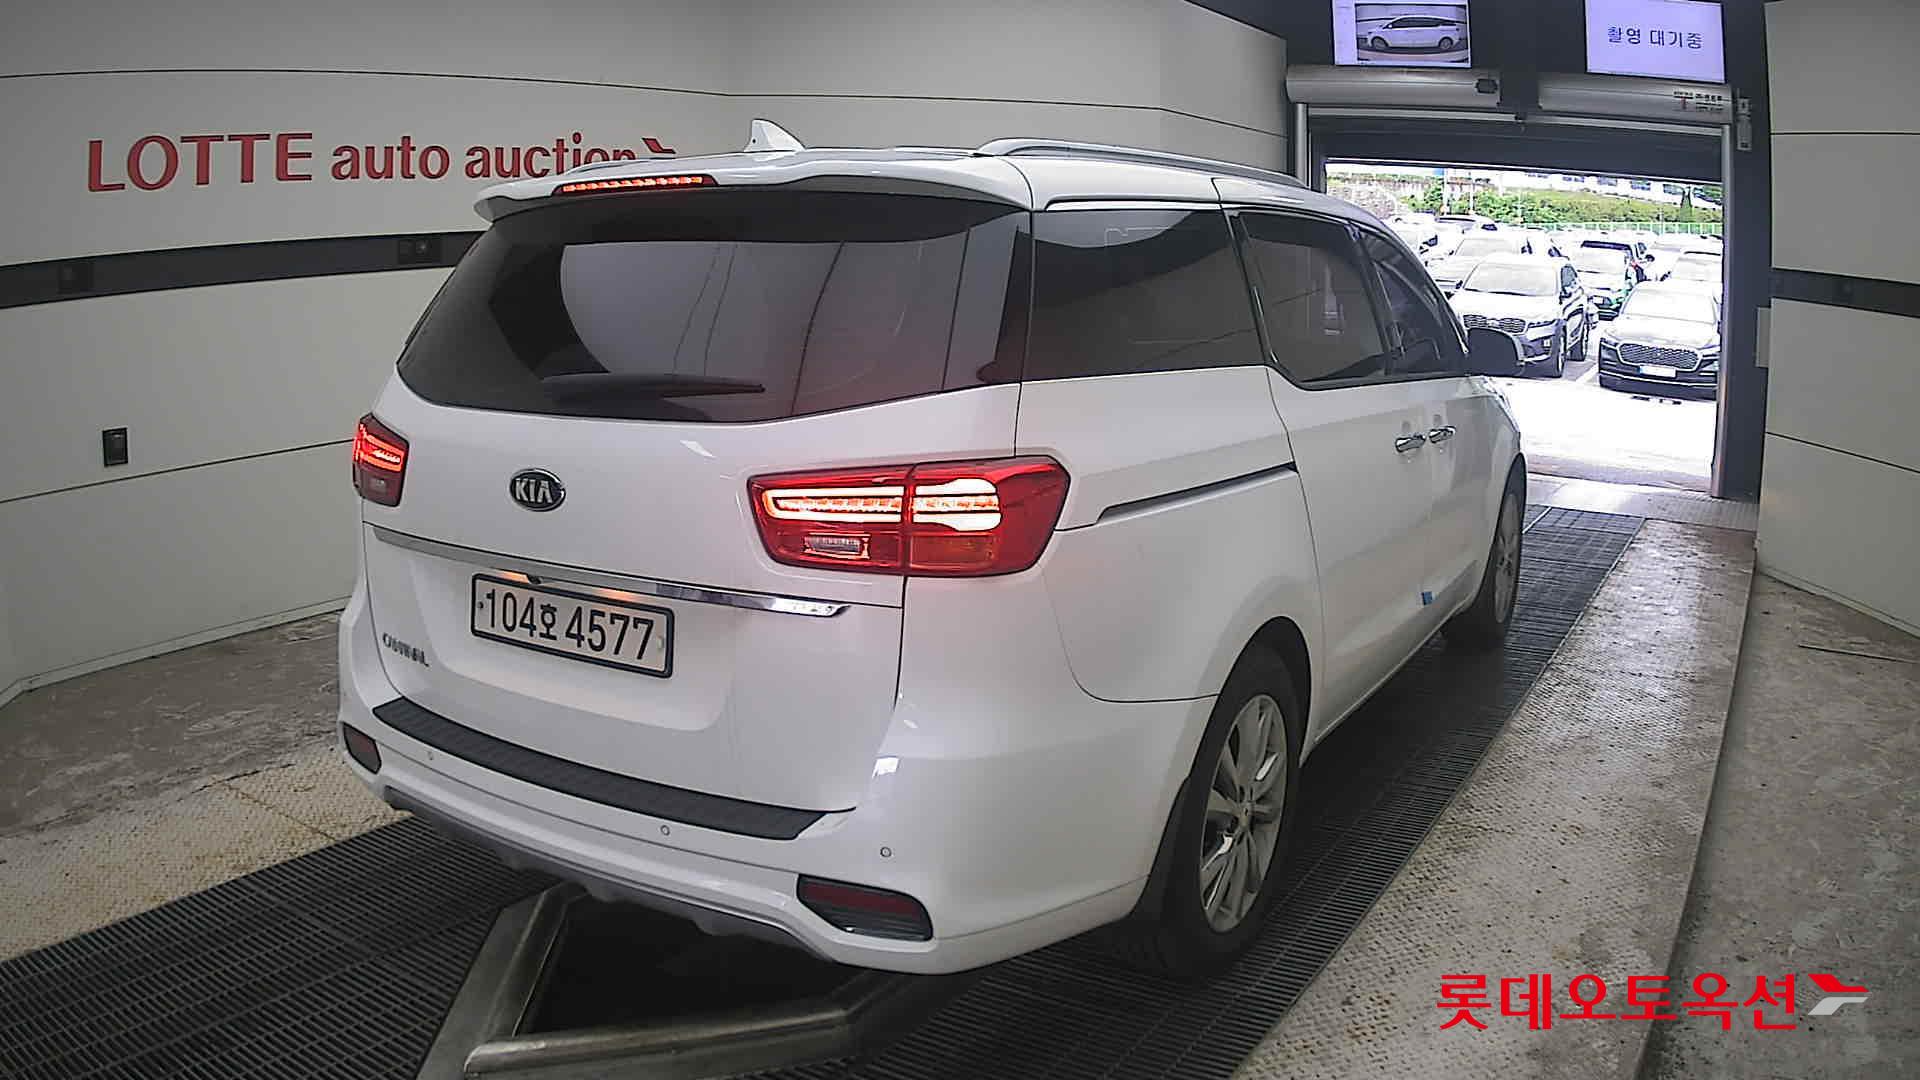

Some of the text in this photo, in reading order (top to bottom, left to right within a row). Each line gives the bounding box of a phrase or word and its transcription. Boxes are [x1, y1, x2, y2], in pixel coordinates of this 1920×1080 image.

[1649, 30, 1702, 49] 대기중
[88, 132, 313, 193] LOTTE
[331, 135, 451, 181] auto
[514, 478, 554, 504] KIA
[486, 588, 654, 660] 104호 4577
